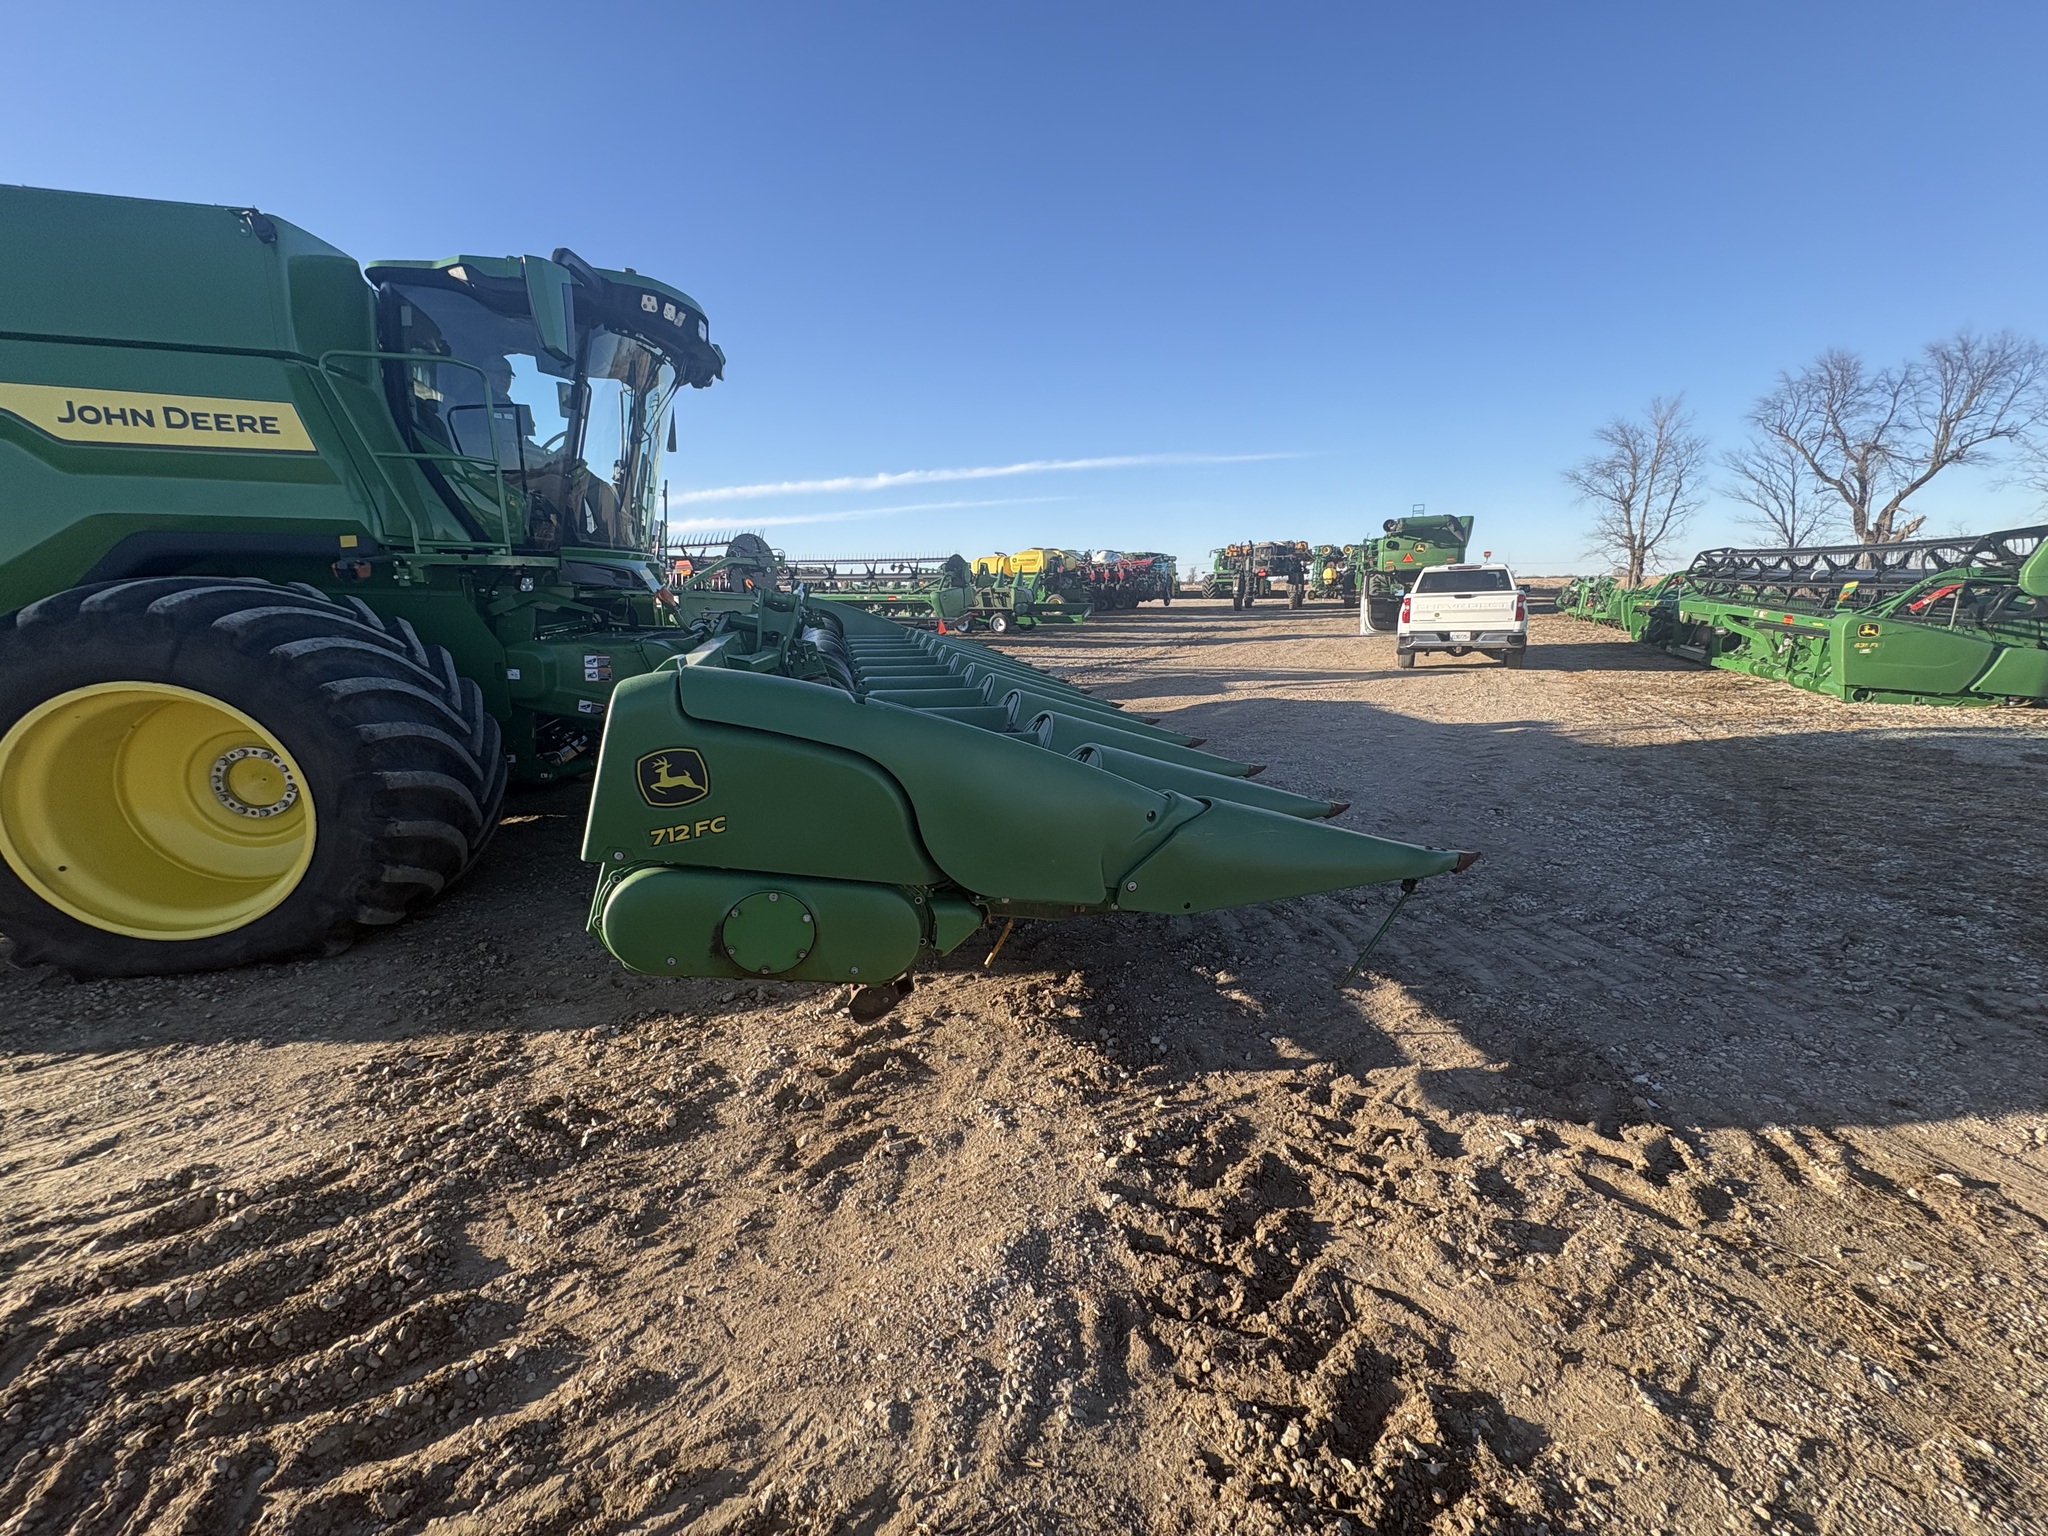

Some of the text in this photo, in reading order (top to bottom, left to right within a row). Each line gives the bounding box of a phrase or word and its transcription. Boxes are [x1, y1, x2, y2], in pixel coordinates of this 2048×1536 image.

[57, 400, 281, 435] JOHN DEERE
[649, 815, 727, 846] 712 FC
